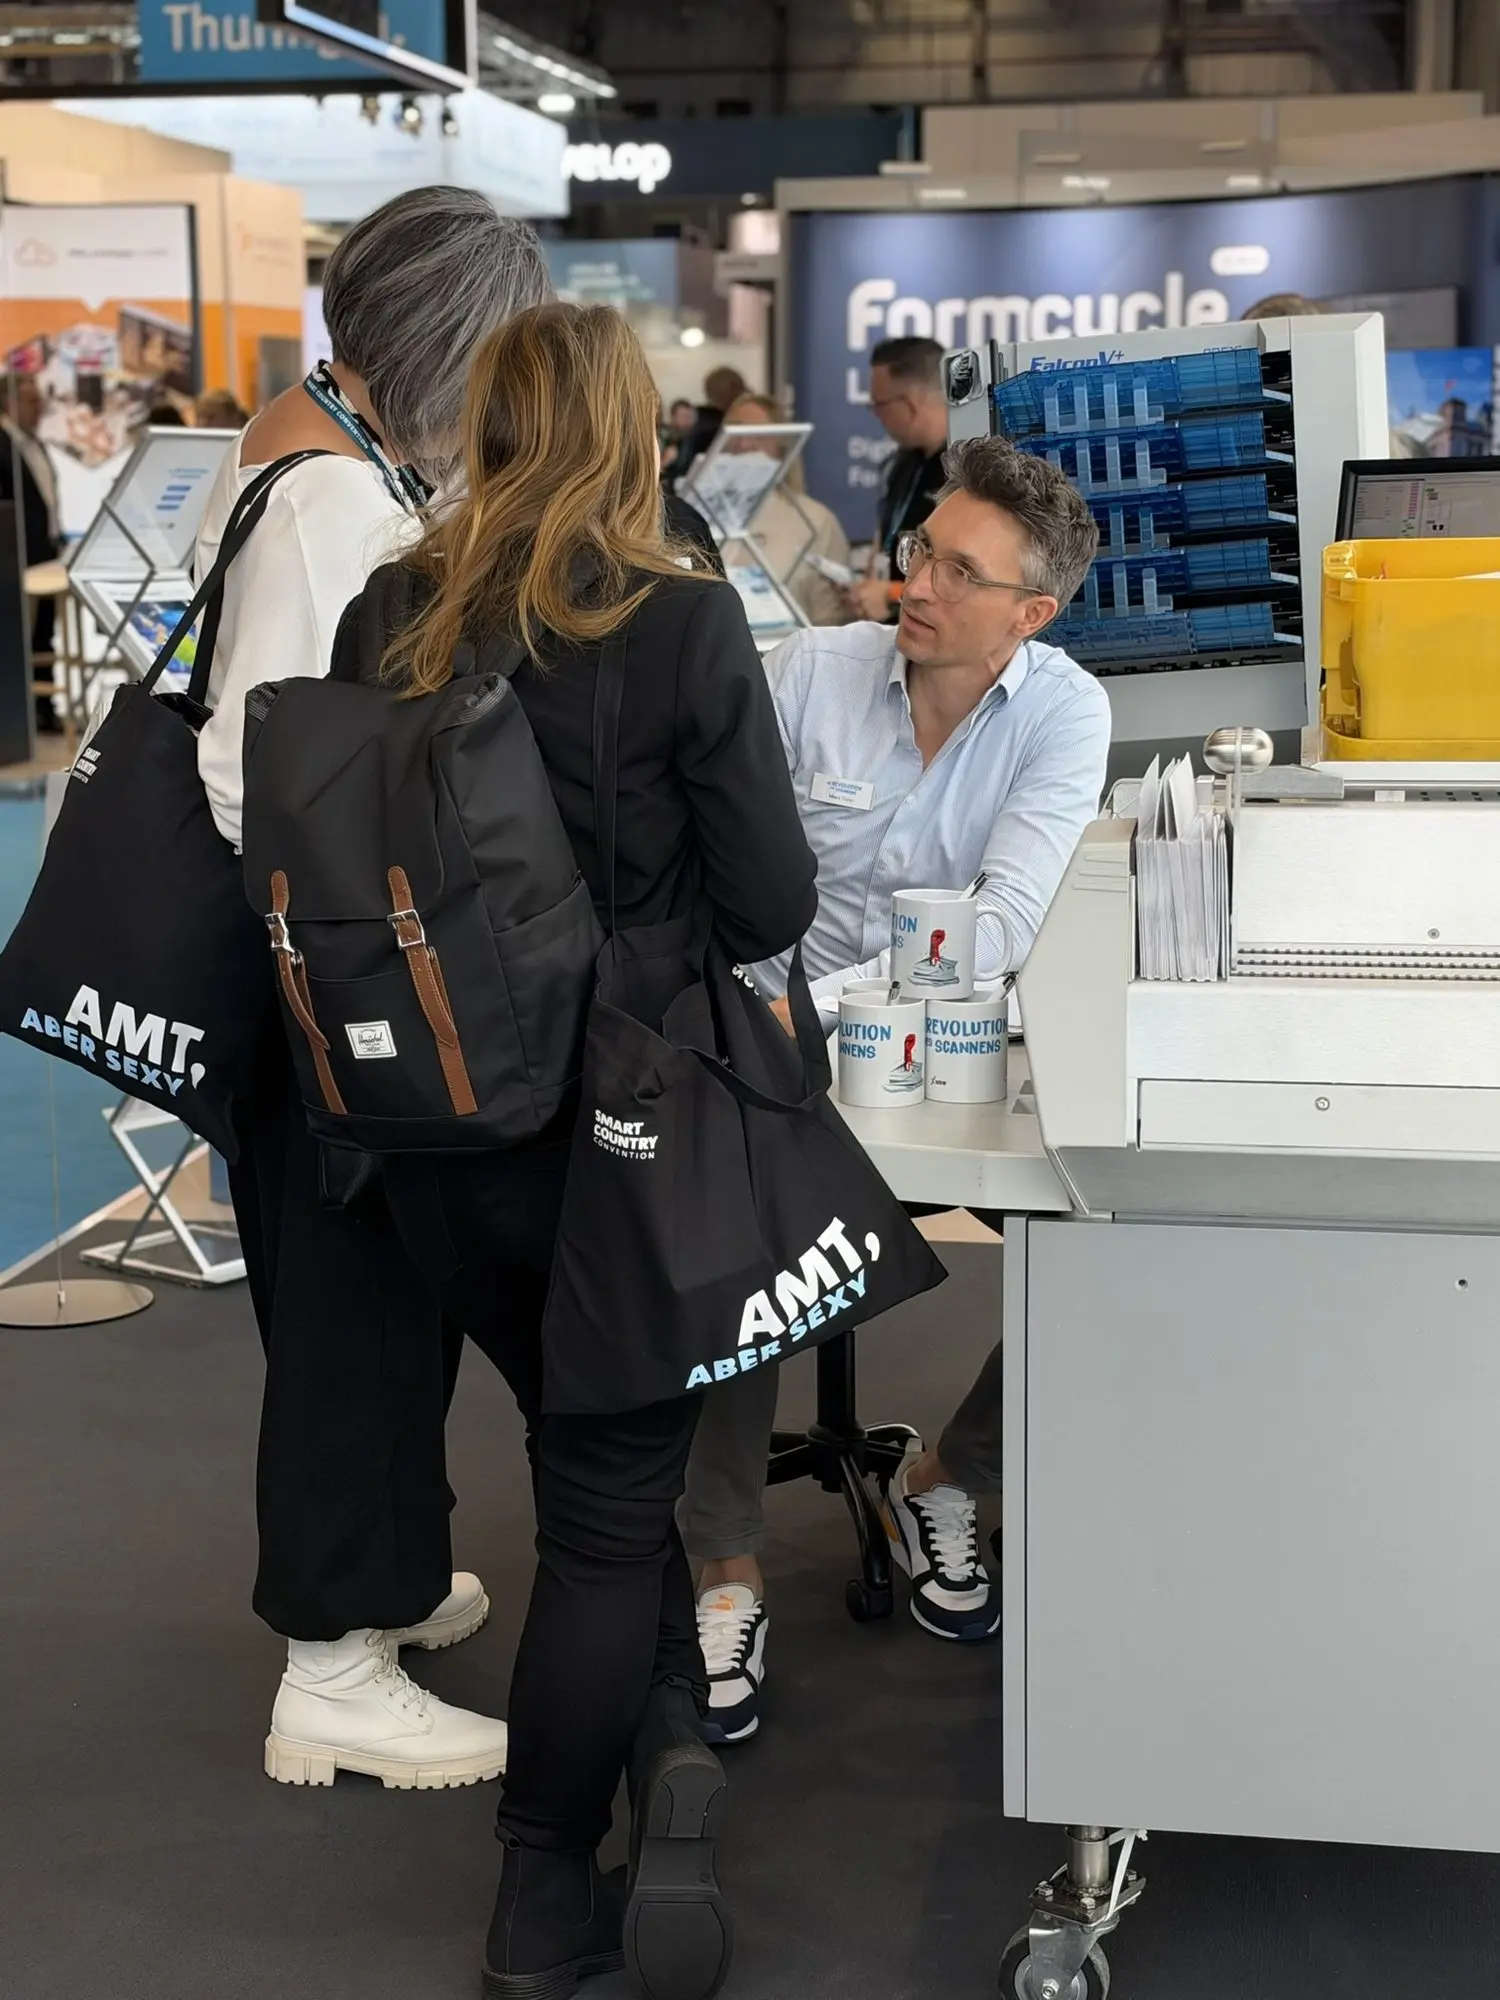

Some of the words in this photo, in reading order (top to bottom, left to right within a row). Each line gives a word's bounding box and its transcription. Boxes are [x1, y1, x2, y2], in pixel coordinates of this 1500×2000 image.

[335, 410, 370, 450] CONVENTION
[20, 1007, 97, 1062] ABER
[104, 1048, 185, 1097] SEXY
[64, 984, 206, 1090] AMT,
[934, 1039, 1002, 1055] SCANNENS
[594, 1124, 659, 1150] COUNTRY
[595, 1109, 645, 1136] SMART
[593, 1136, 655, 1160] CONVENTION
[737, 1216, 881, 1347] AMT,
[685, 1342, 783, 1390] ABER
[788, 1267, 868, 1343] SEXY
